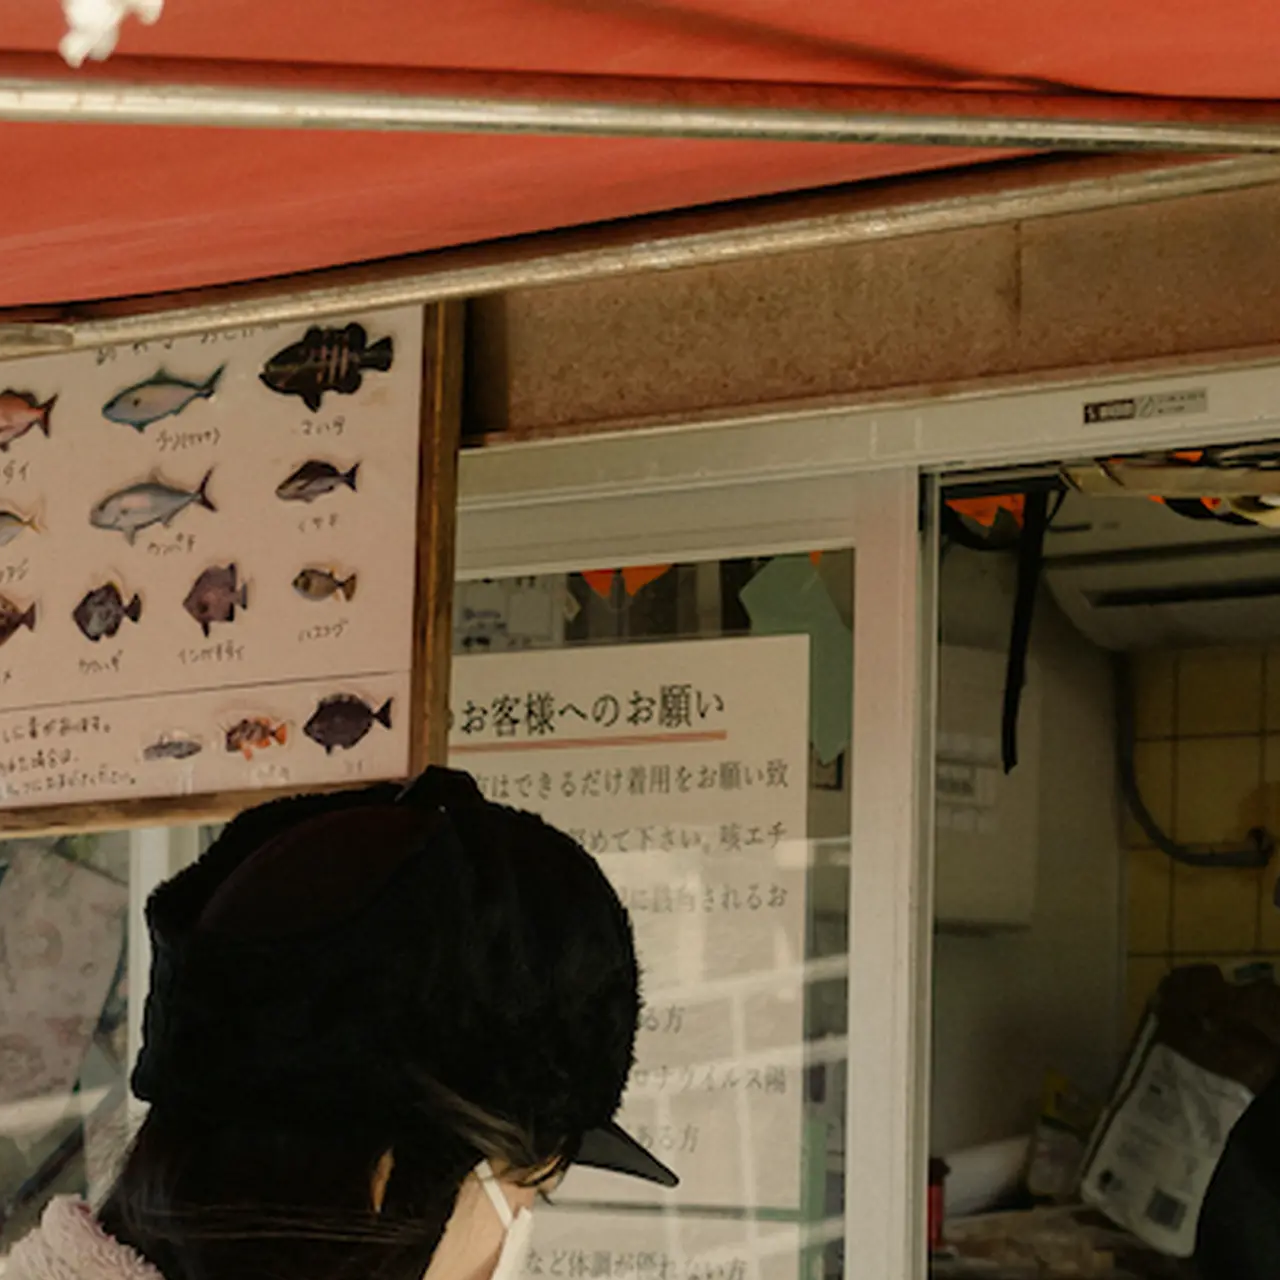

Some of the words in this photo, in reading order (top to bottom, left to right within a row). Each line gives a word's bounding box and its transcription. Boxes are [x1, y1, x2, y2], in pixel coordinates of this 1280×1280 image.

[459, 683, 726, 737] お客様へのお願い
